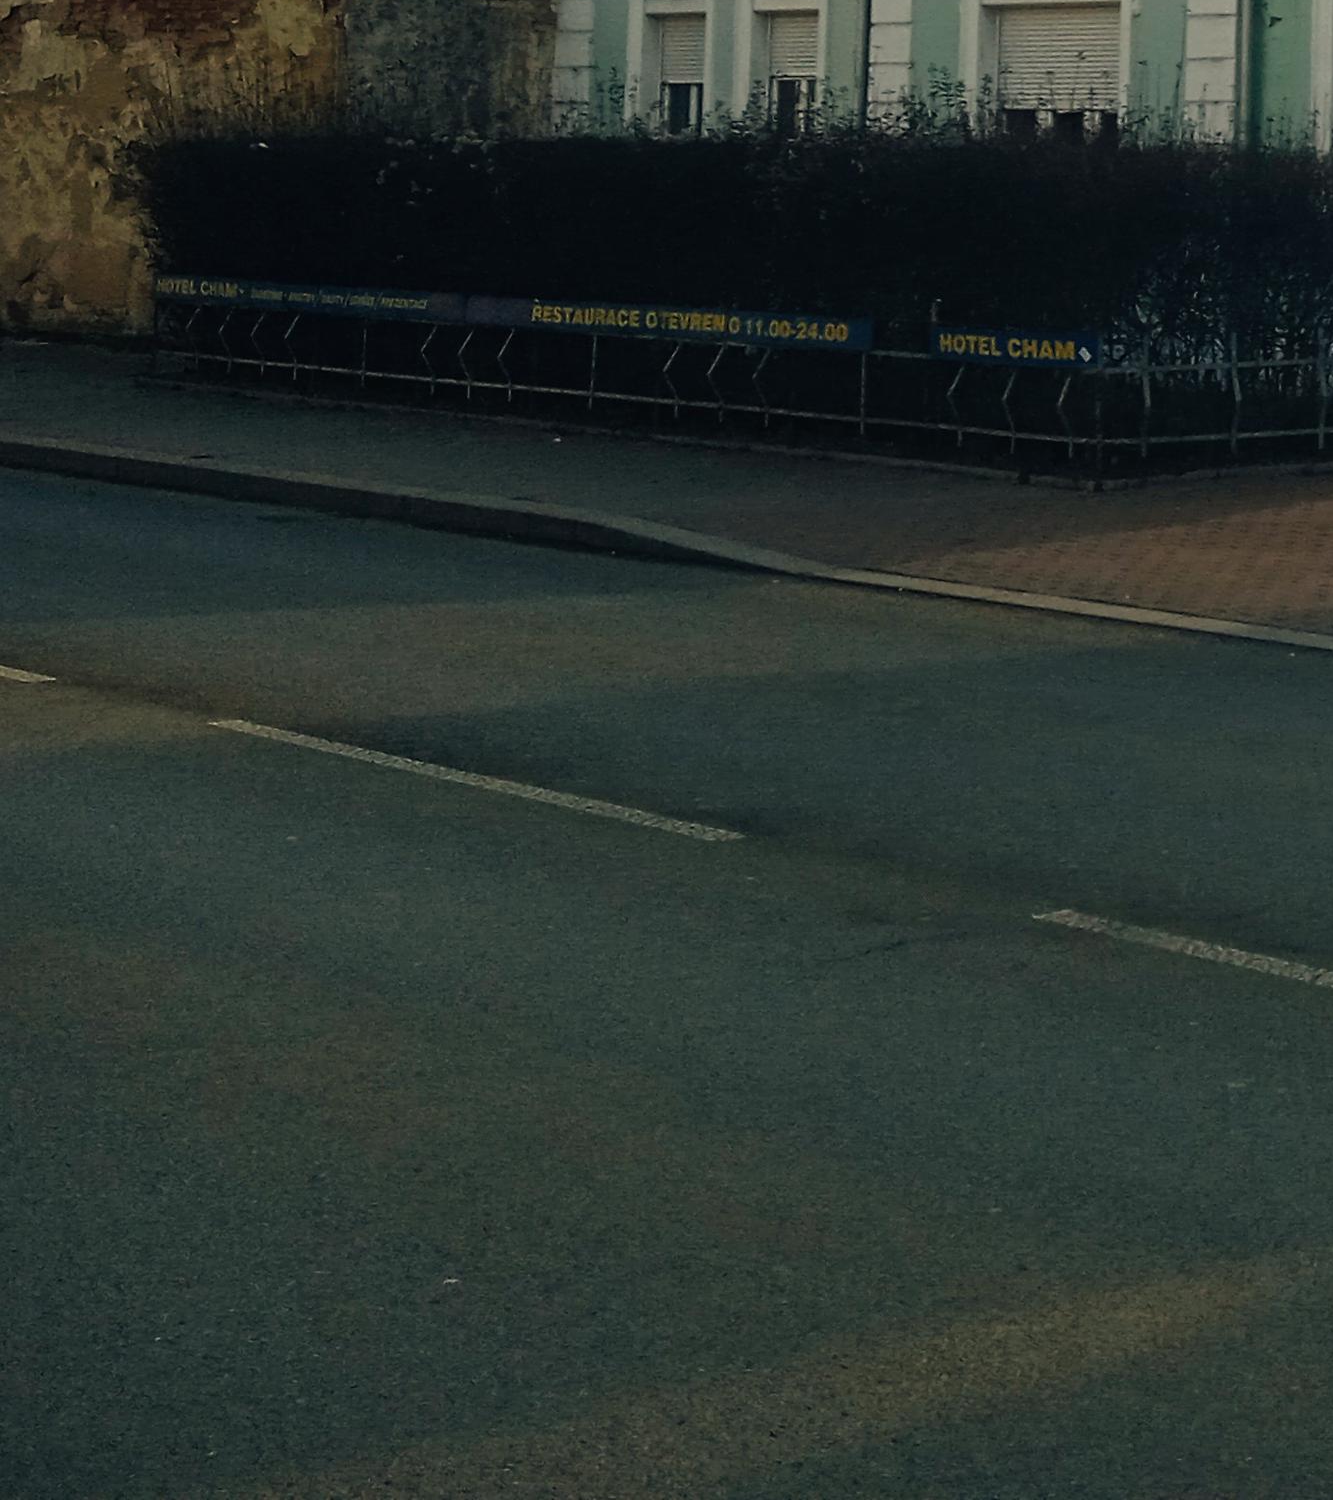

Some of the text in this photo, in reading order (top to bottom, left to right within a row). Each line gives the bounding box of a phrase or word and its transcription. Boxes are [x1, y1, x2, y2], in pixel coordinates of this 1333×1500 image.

[156, 278, 238, 298] HOTEL CHAM
[530, 304, 640, 328] RESTAURACE
[745, 317, 850, 342] 11.00-24.00
[938, 332, 1076, 362] HOTEL CHAM
